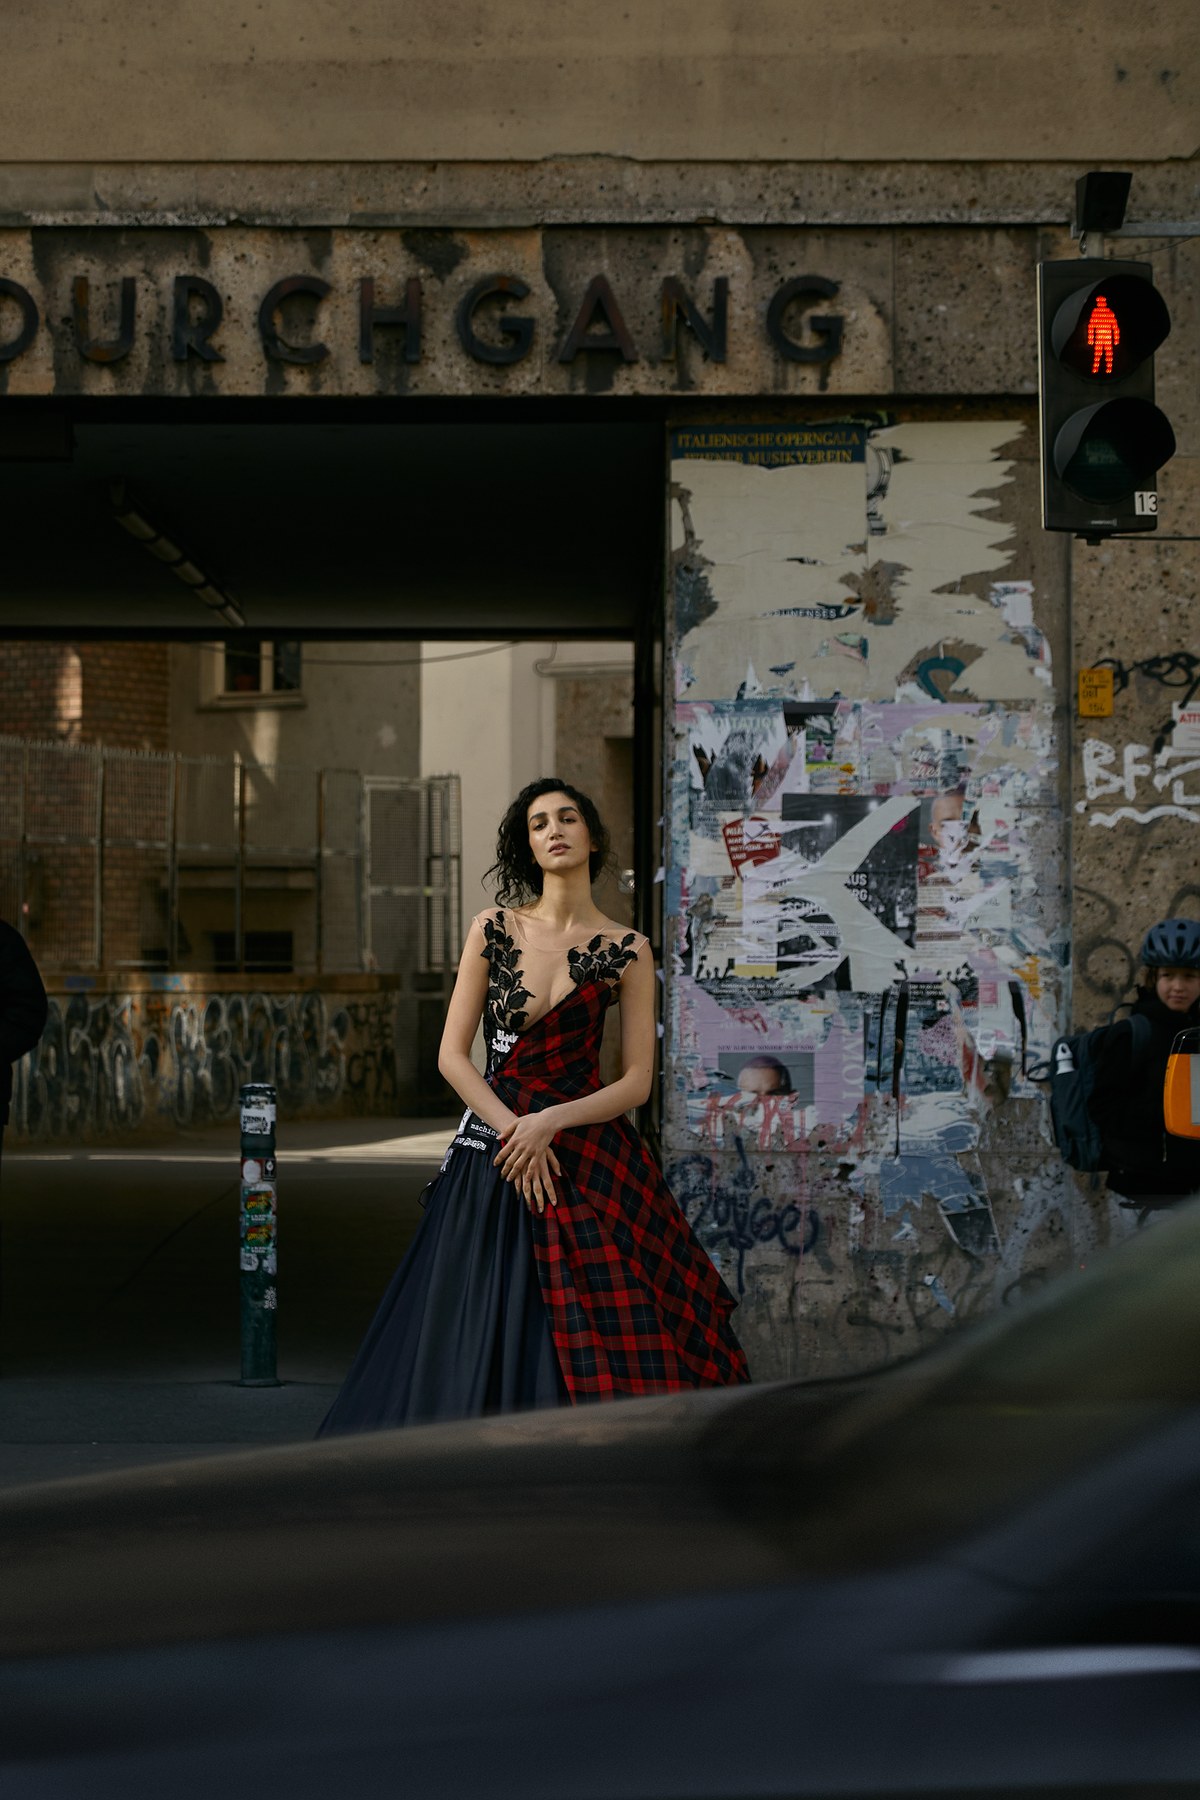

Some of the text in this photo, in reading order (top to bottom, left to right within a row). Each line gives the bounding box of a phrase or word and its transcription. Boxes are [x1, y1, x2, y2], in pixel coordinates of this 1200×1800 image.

[677, 431, 860, 448] ITALIENISCHE OPERNGALA
[1138, 493, 1158, 513] 13
